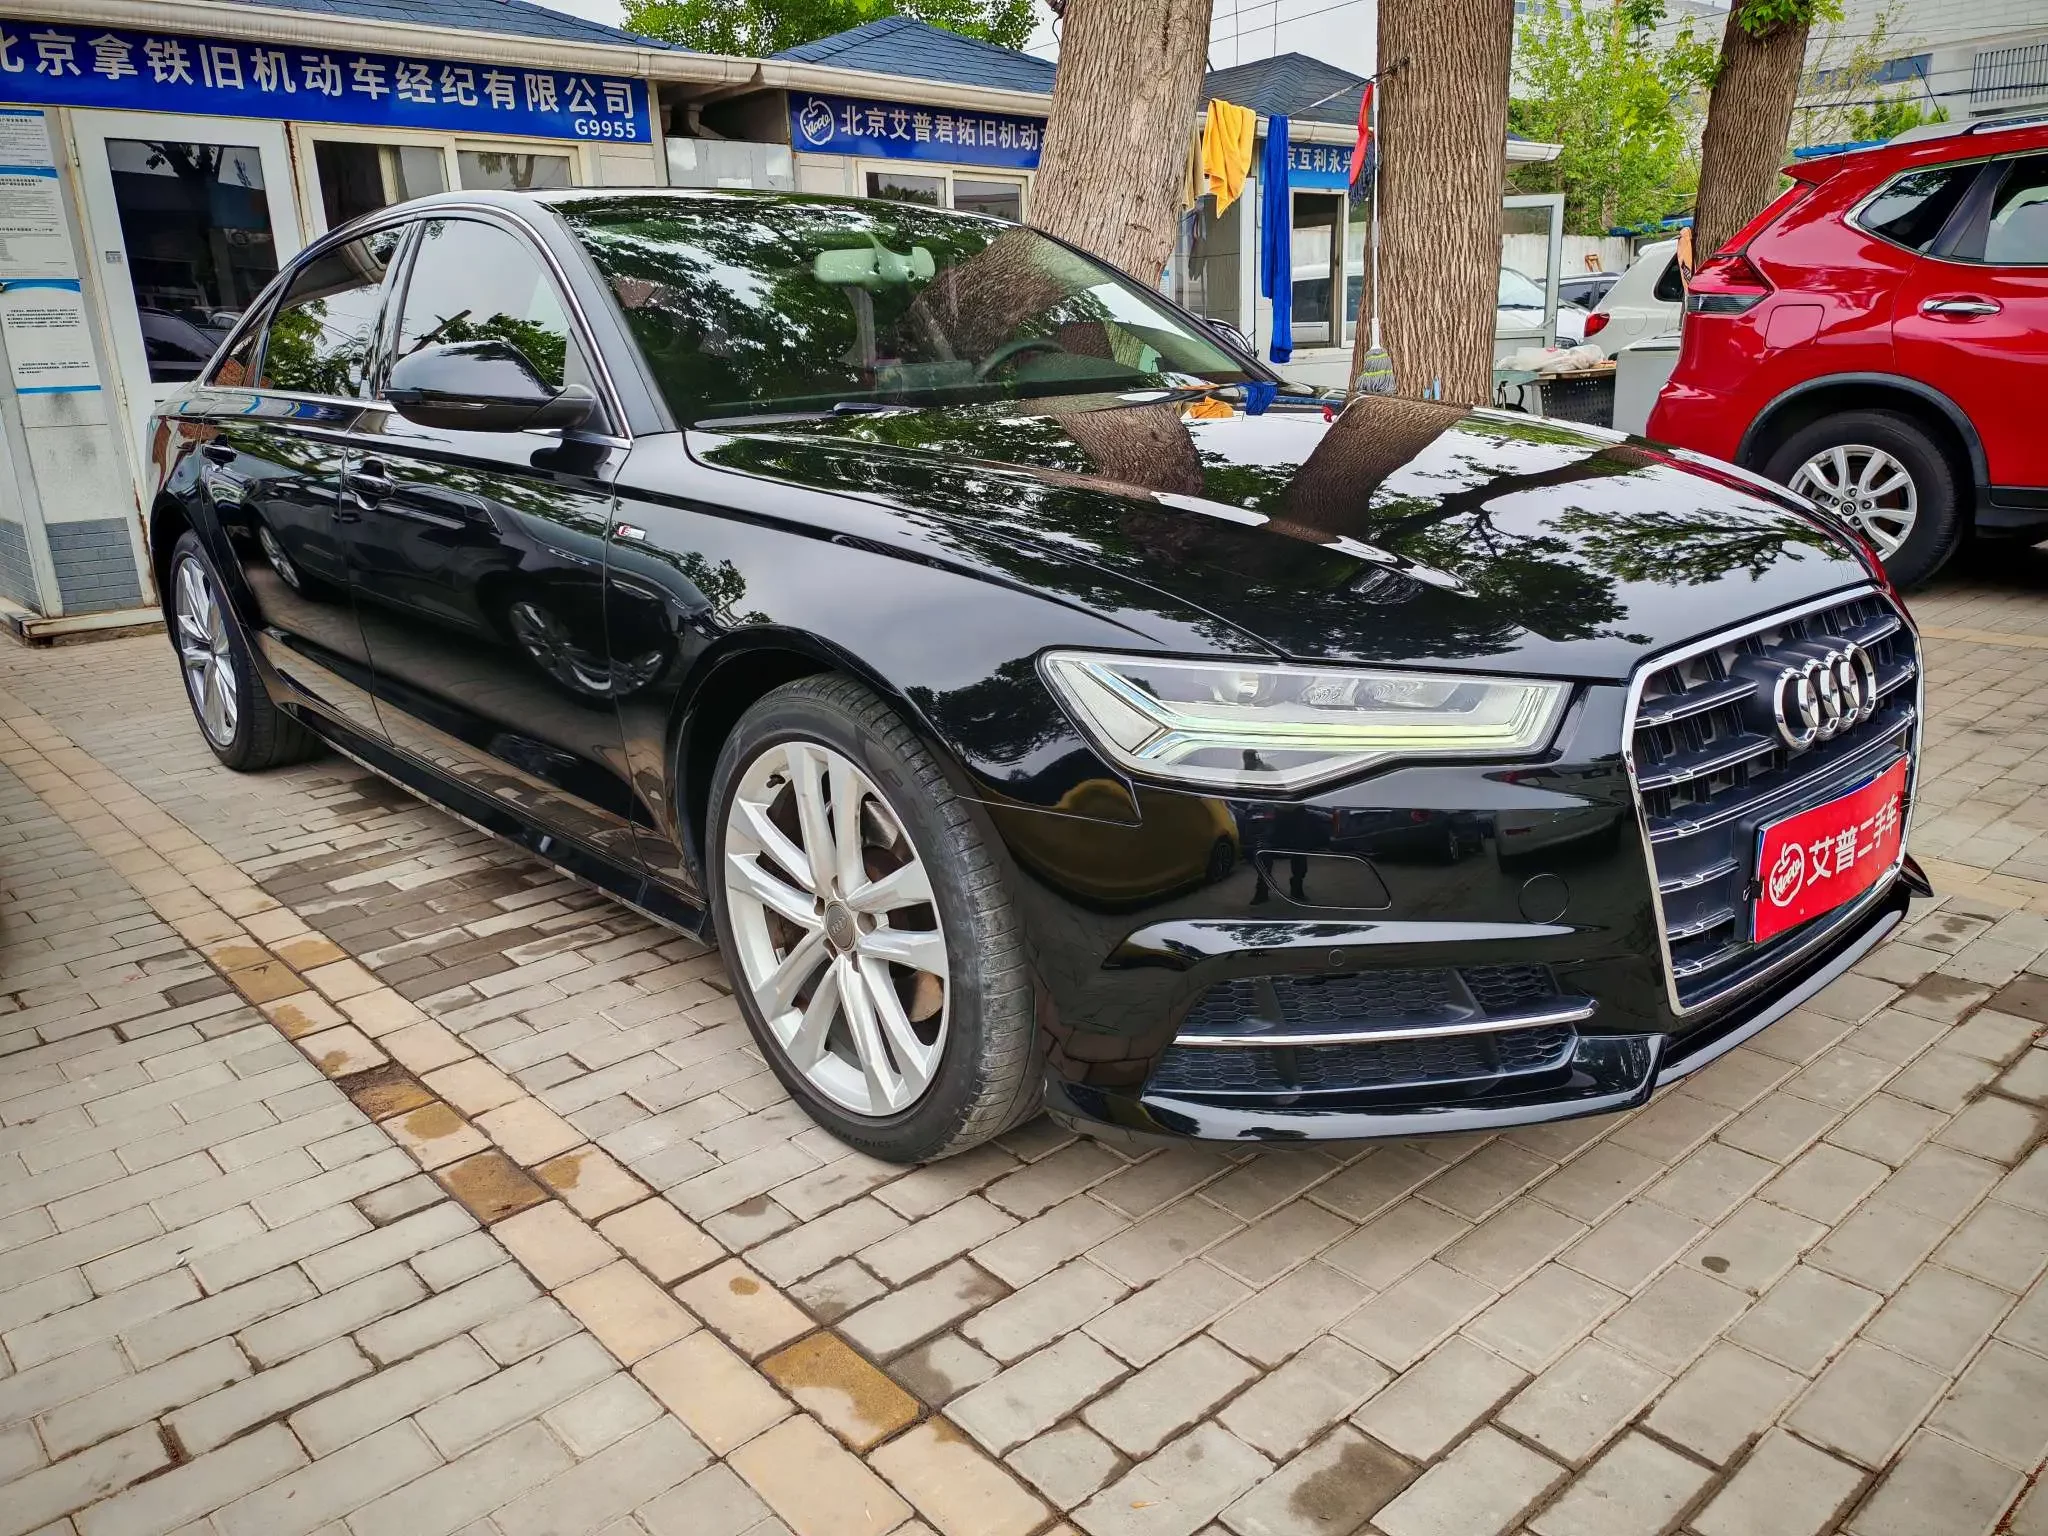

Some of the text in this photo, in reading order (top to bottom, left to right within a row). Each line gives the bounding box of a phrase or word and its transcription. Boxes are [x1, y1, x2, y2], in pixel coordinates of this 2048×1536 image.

[574, 118, 636, 139] G9955
[840, 105, 1047, 151] 北京艾普君拓旧机动
[1807, 794, 1898, 886] 艾普二手车
